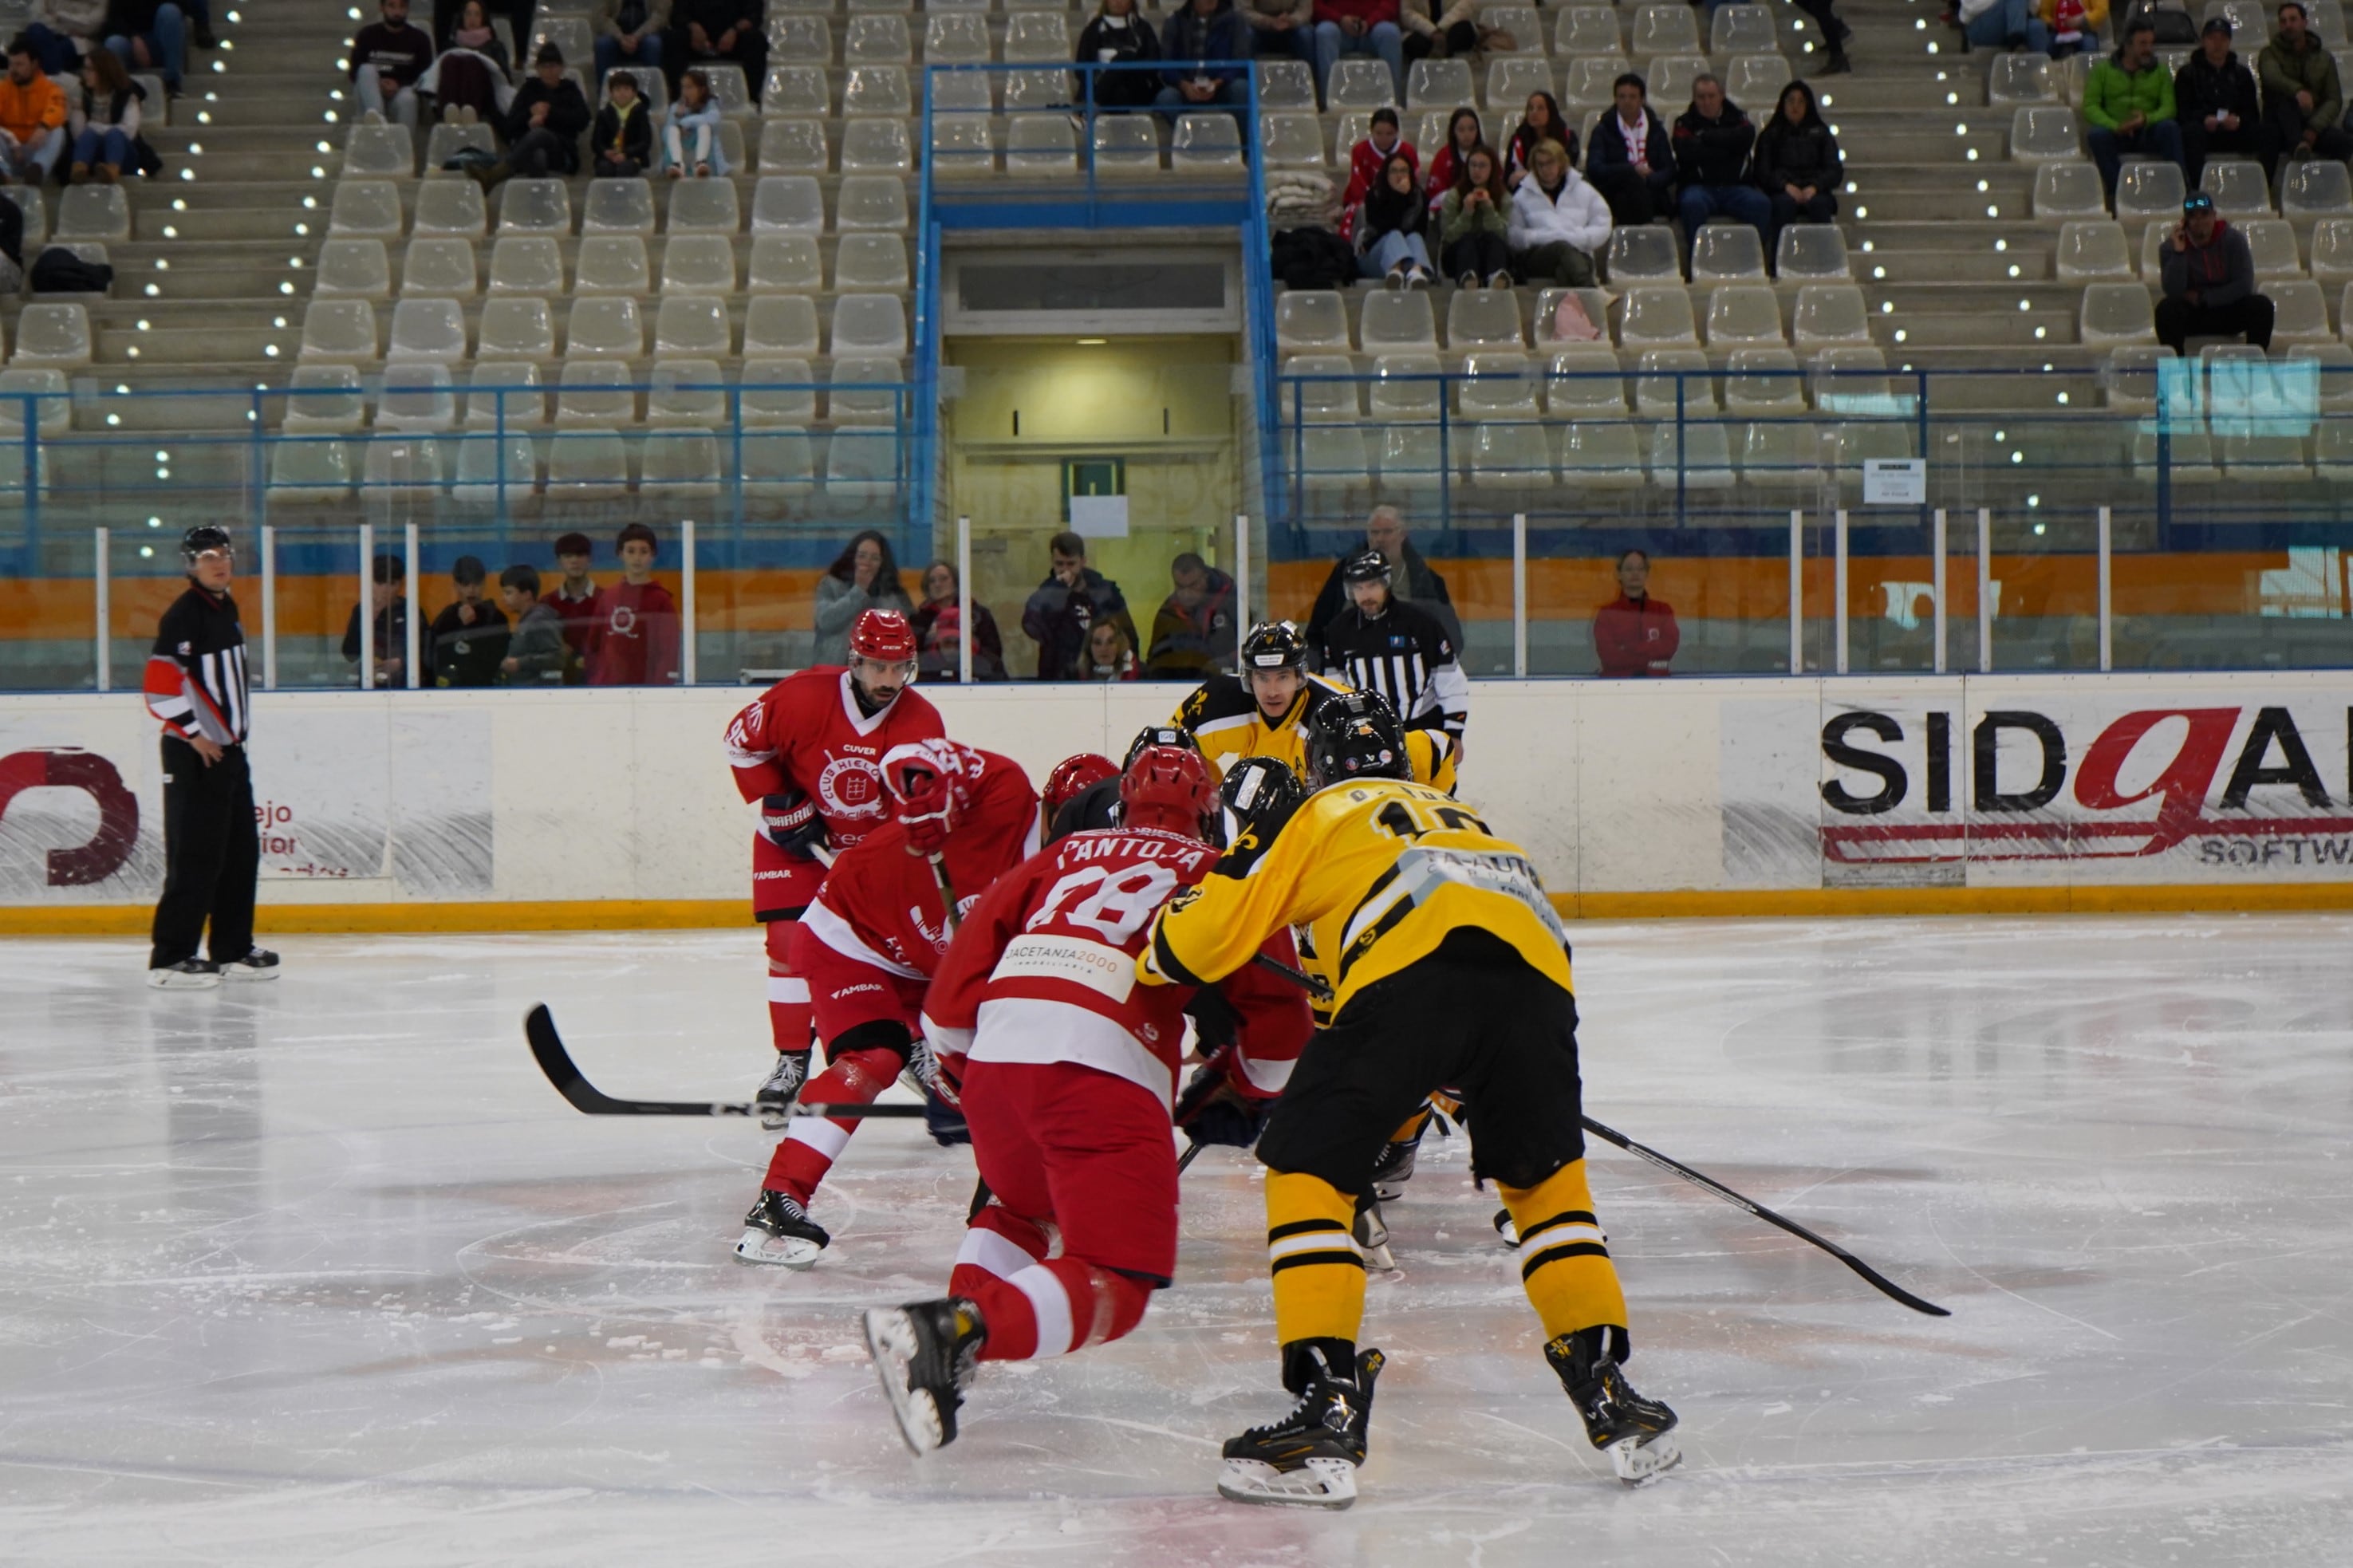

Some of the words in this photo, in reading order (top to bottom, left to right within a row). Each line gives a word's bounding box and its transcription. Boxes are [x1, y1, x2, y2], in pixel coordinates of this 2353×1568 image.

[843, 744, 877, 756] CUVER
[822, 768, 835, 799] CLUB
[837, 760, 879, 777] HIELO
[1057, 837, 1205, 873] PANTOJA
[2201, 839, 2353, 866] SOFTW
[758, 869, 792, 880] AMBAR
[1006, 947, 1117, 973] JACETANIA2000
[841, 983, 885, 997] AMBAR
